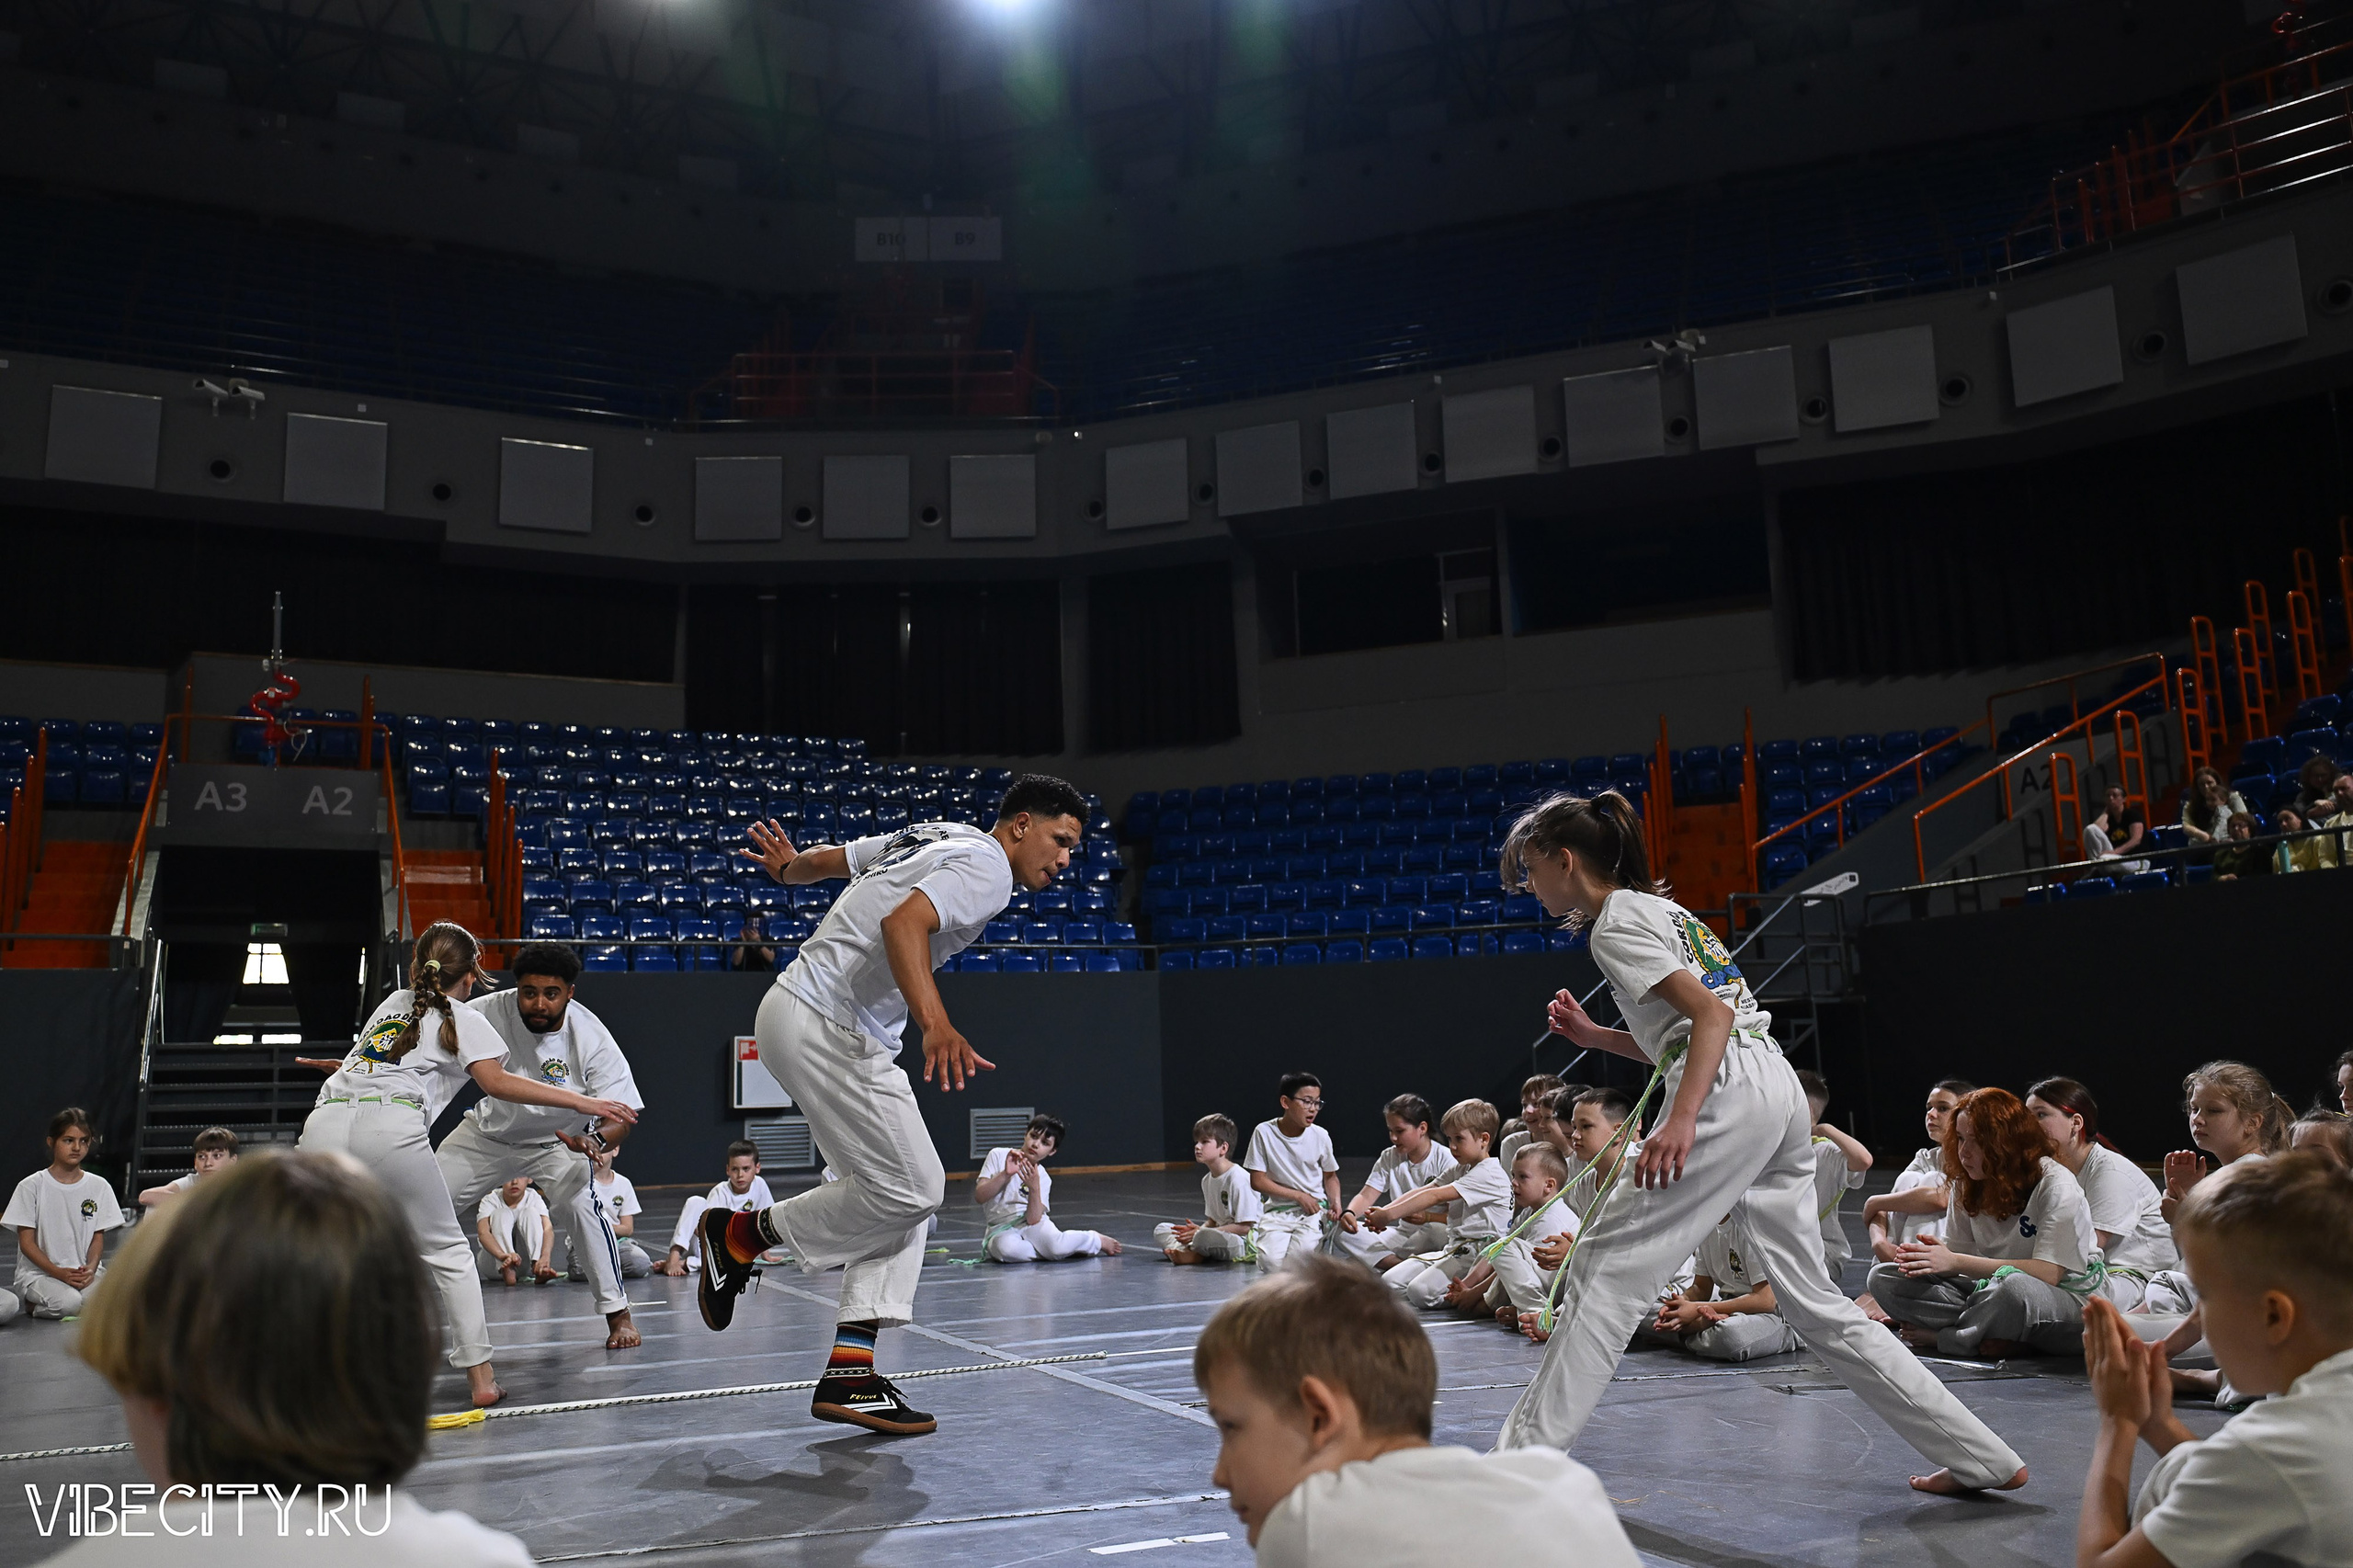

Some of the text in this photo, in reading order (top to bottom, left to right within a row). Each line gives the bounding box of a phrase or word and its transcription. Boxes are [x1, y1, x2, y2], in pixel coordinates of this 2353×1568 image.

[877, 233, 905, 245] B10
[954, 232, 976, 245] B9
[194, 781, 353, 815] A3 A2
